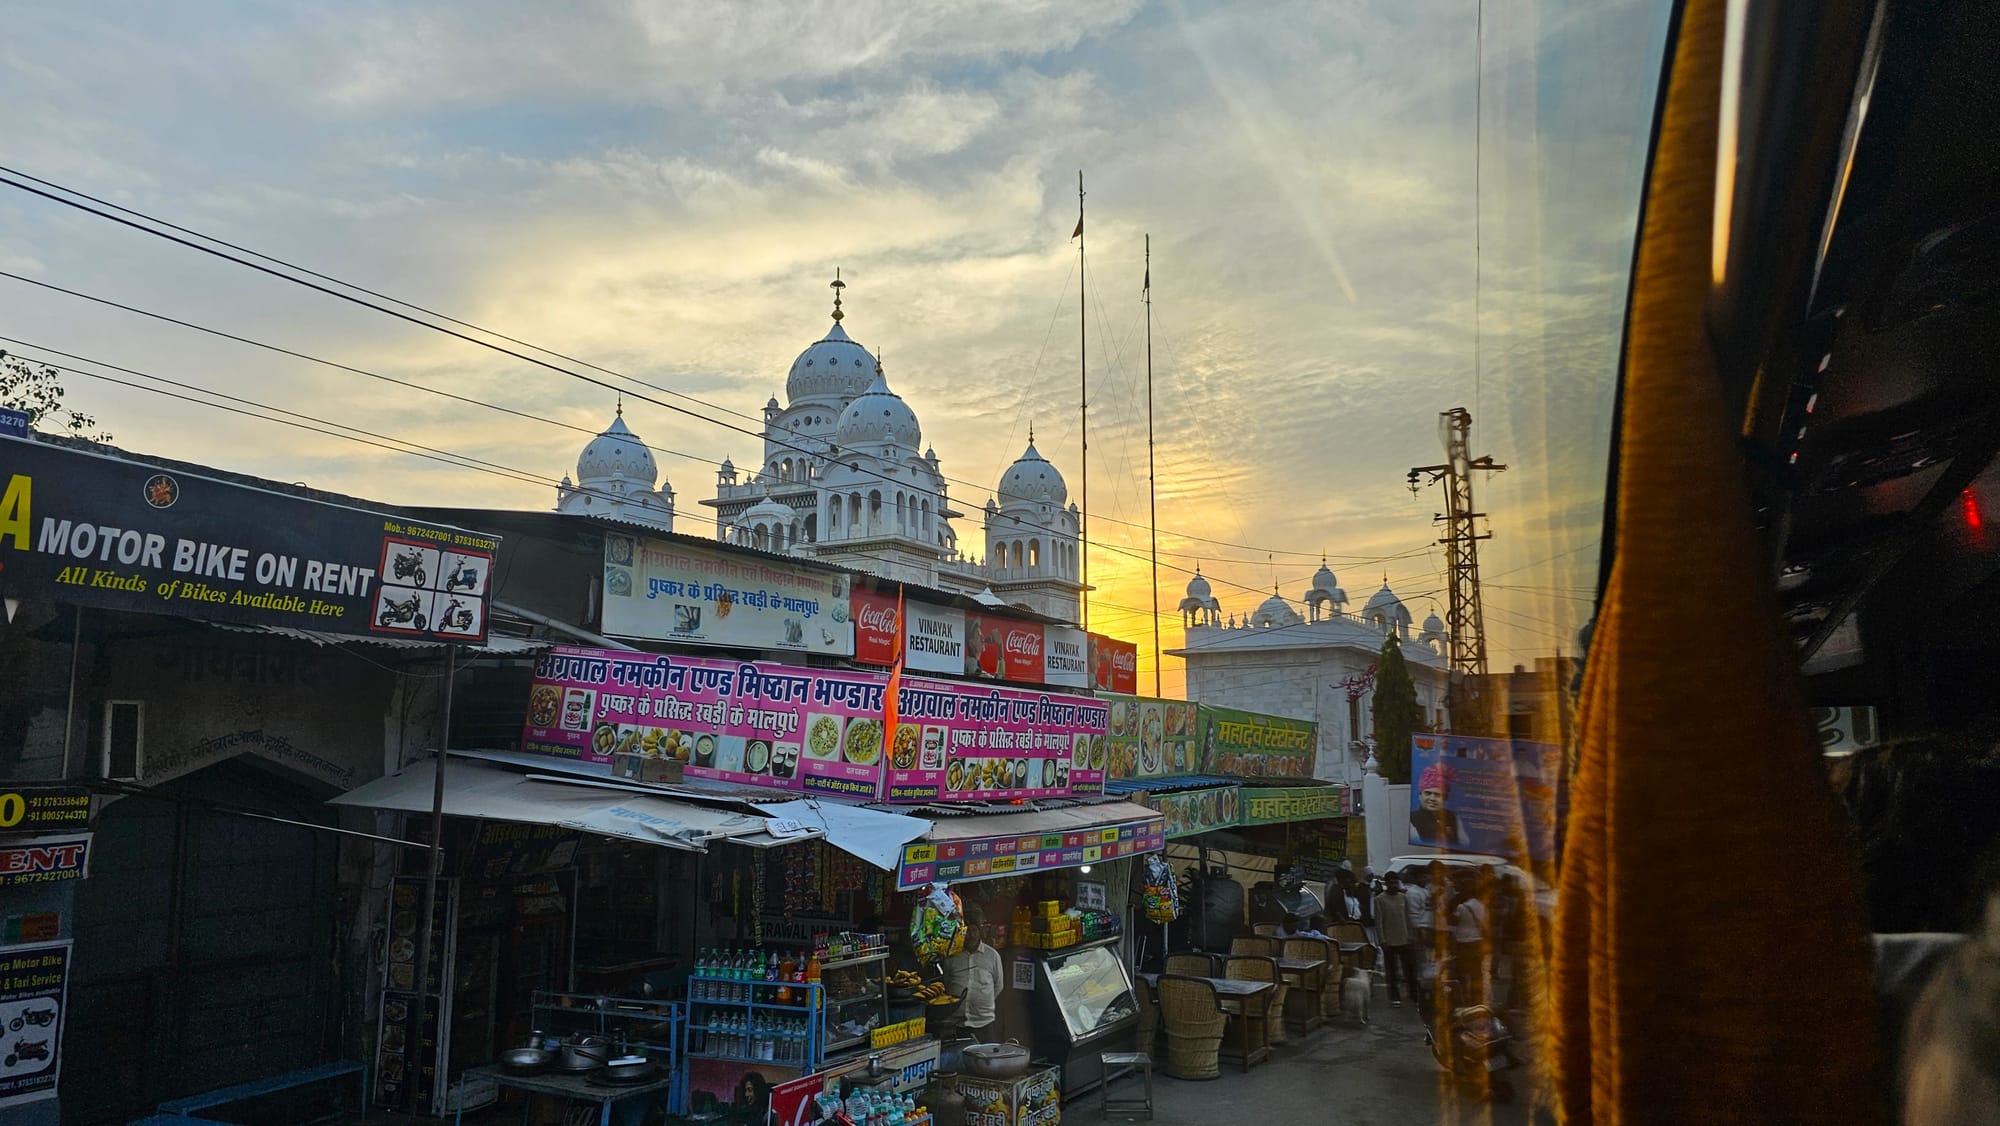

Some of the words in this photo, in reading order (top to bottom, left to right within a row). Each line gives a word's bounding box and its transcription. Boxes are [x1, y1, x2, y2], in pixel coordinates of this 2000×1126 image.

[37, 517, 166, 569] MOTOR
[172, 538, 249, 582] BIKE
[255, 552, 298, 588] ON
[304, 560, 375, 597] RENT
[56, 566, 88, 585] All
[90, 570, 148, 592] Kinds
[157, 579, 180, 600] of
[180, 583, 228, 603] Bikes
[231, 590, 306, 613] Available
[308, 600, 345, 618] Here
[648, 577, 684, 599] पुष्कर
[687, 580, 701, 598] के
[742, 590, 768, 611] रबड़ी
[769, 593, 782, 610] के
[918, 618, 953, 639] VINAYAK
[909, 635, 961, 657] RESTAURANT
[1053, 641, 1080, 657] VINAYAK
[1047, 655, 1086, 673] RESTAURANT
[535, 654, 611, 684] अग्रवाल
[611, 655, 688, 692] नमकीन
[689, 666, 735, 698] एण्ड
[736, 665, 813, 705] मिष्ठान
[814, 677, 887, 713] भण्डार
[597, 692, 636, 718] पुष्कर
[637, 692, 651, 716] के
[653, 694, 693, 720] प्रसिद्ध
[695, 699, 727, 729] रबड़ी
[729, 701, 745, 727] के
[898, 688, 959, 720] अग्रवाल
[959, 690, 1012, 723] नमकीन
[1011, 699, 1039, 725] एण्ड
[1038, 695, 1076, 728] मिष्ठान
[1076, 703, 1110, 730] भण्डार
[948, 729, 977, 755] पुष्कर
[978, 726, 988, 749] के
[988, 727, 1014, 750] प्रसिद्ध
[1014, 728, 1033, 755] रबड़ी
[1034, 729, 1042, 750] के
[1218, 716, 1263, 750] महादेव
[1250, 790, 1300, 820] महादेव
[12, 958, 40, 970] Motor
[42, 955, 62, 967] Bike
[4, 979, 11, 990] &
[13, 976, 30, 989] Taxi
[31, 973, 62, 986] Service
